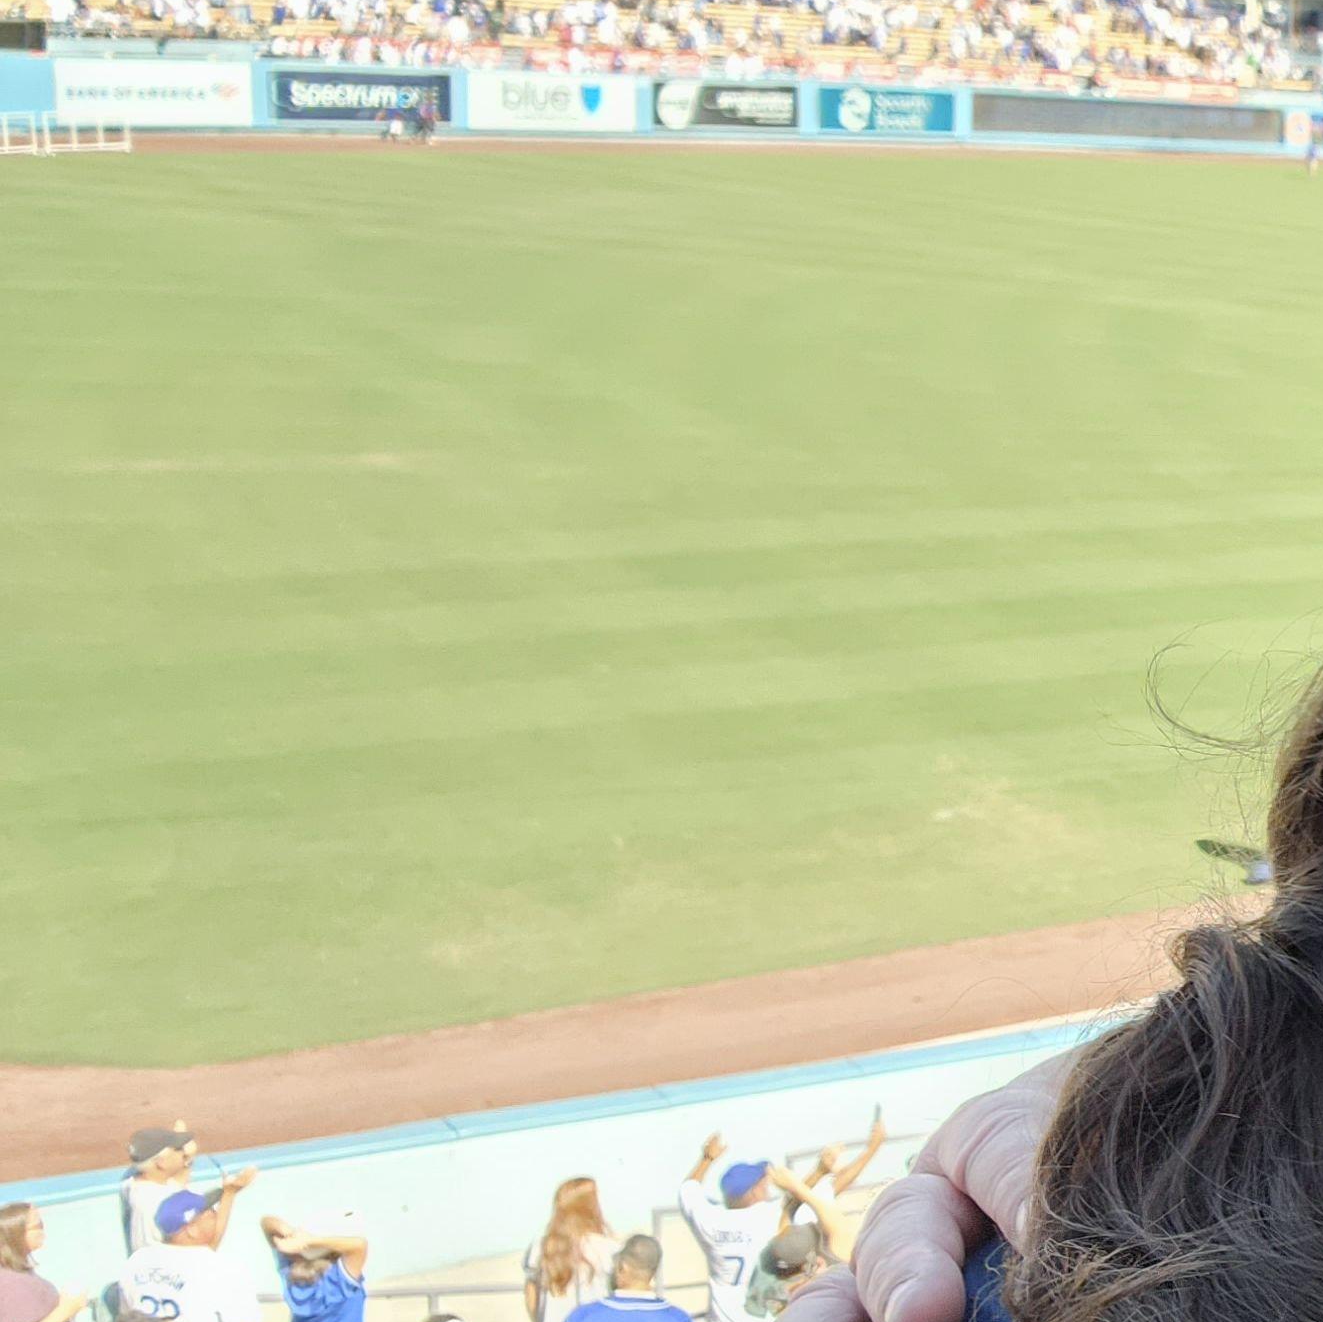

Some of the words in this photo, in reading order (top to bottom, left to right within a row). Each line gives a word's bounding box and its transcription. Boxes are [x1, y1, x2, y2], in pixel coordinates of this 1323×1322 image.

[290, 79, 398, 109] Spectrum
[501, 79, 571, 111] blue
[722, 1255, 746, 1286] 7
